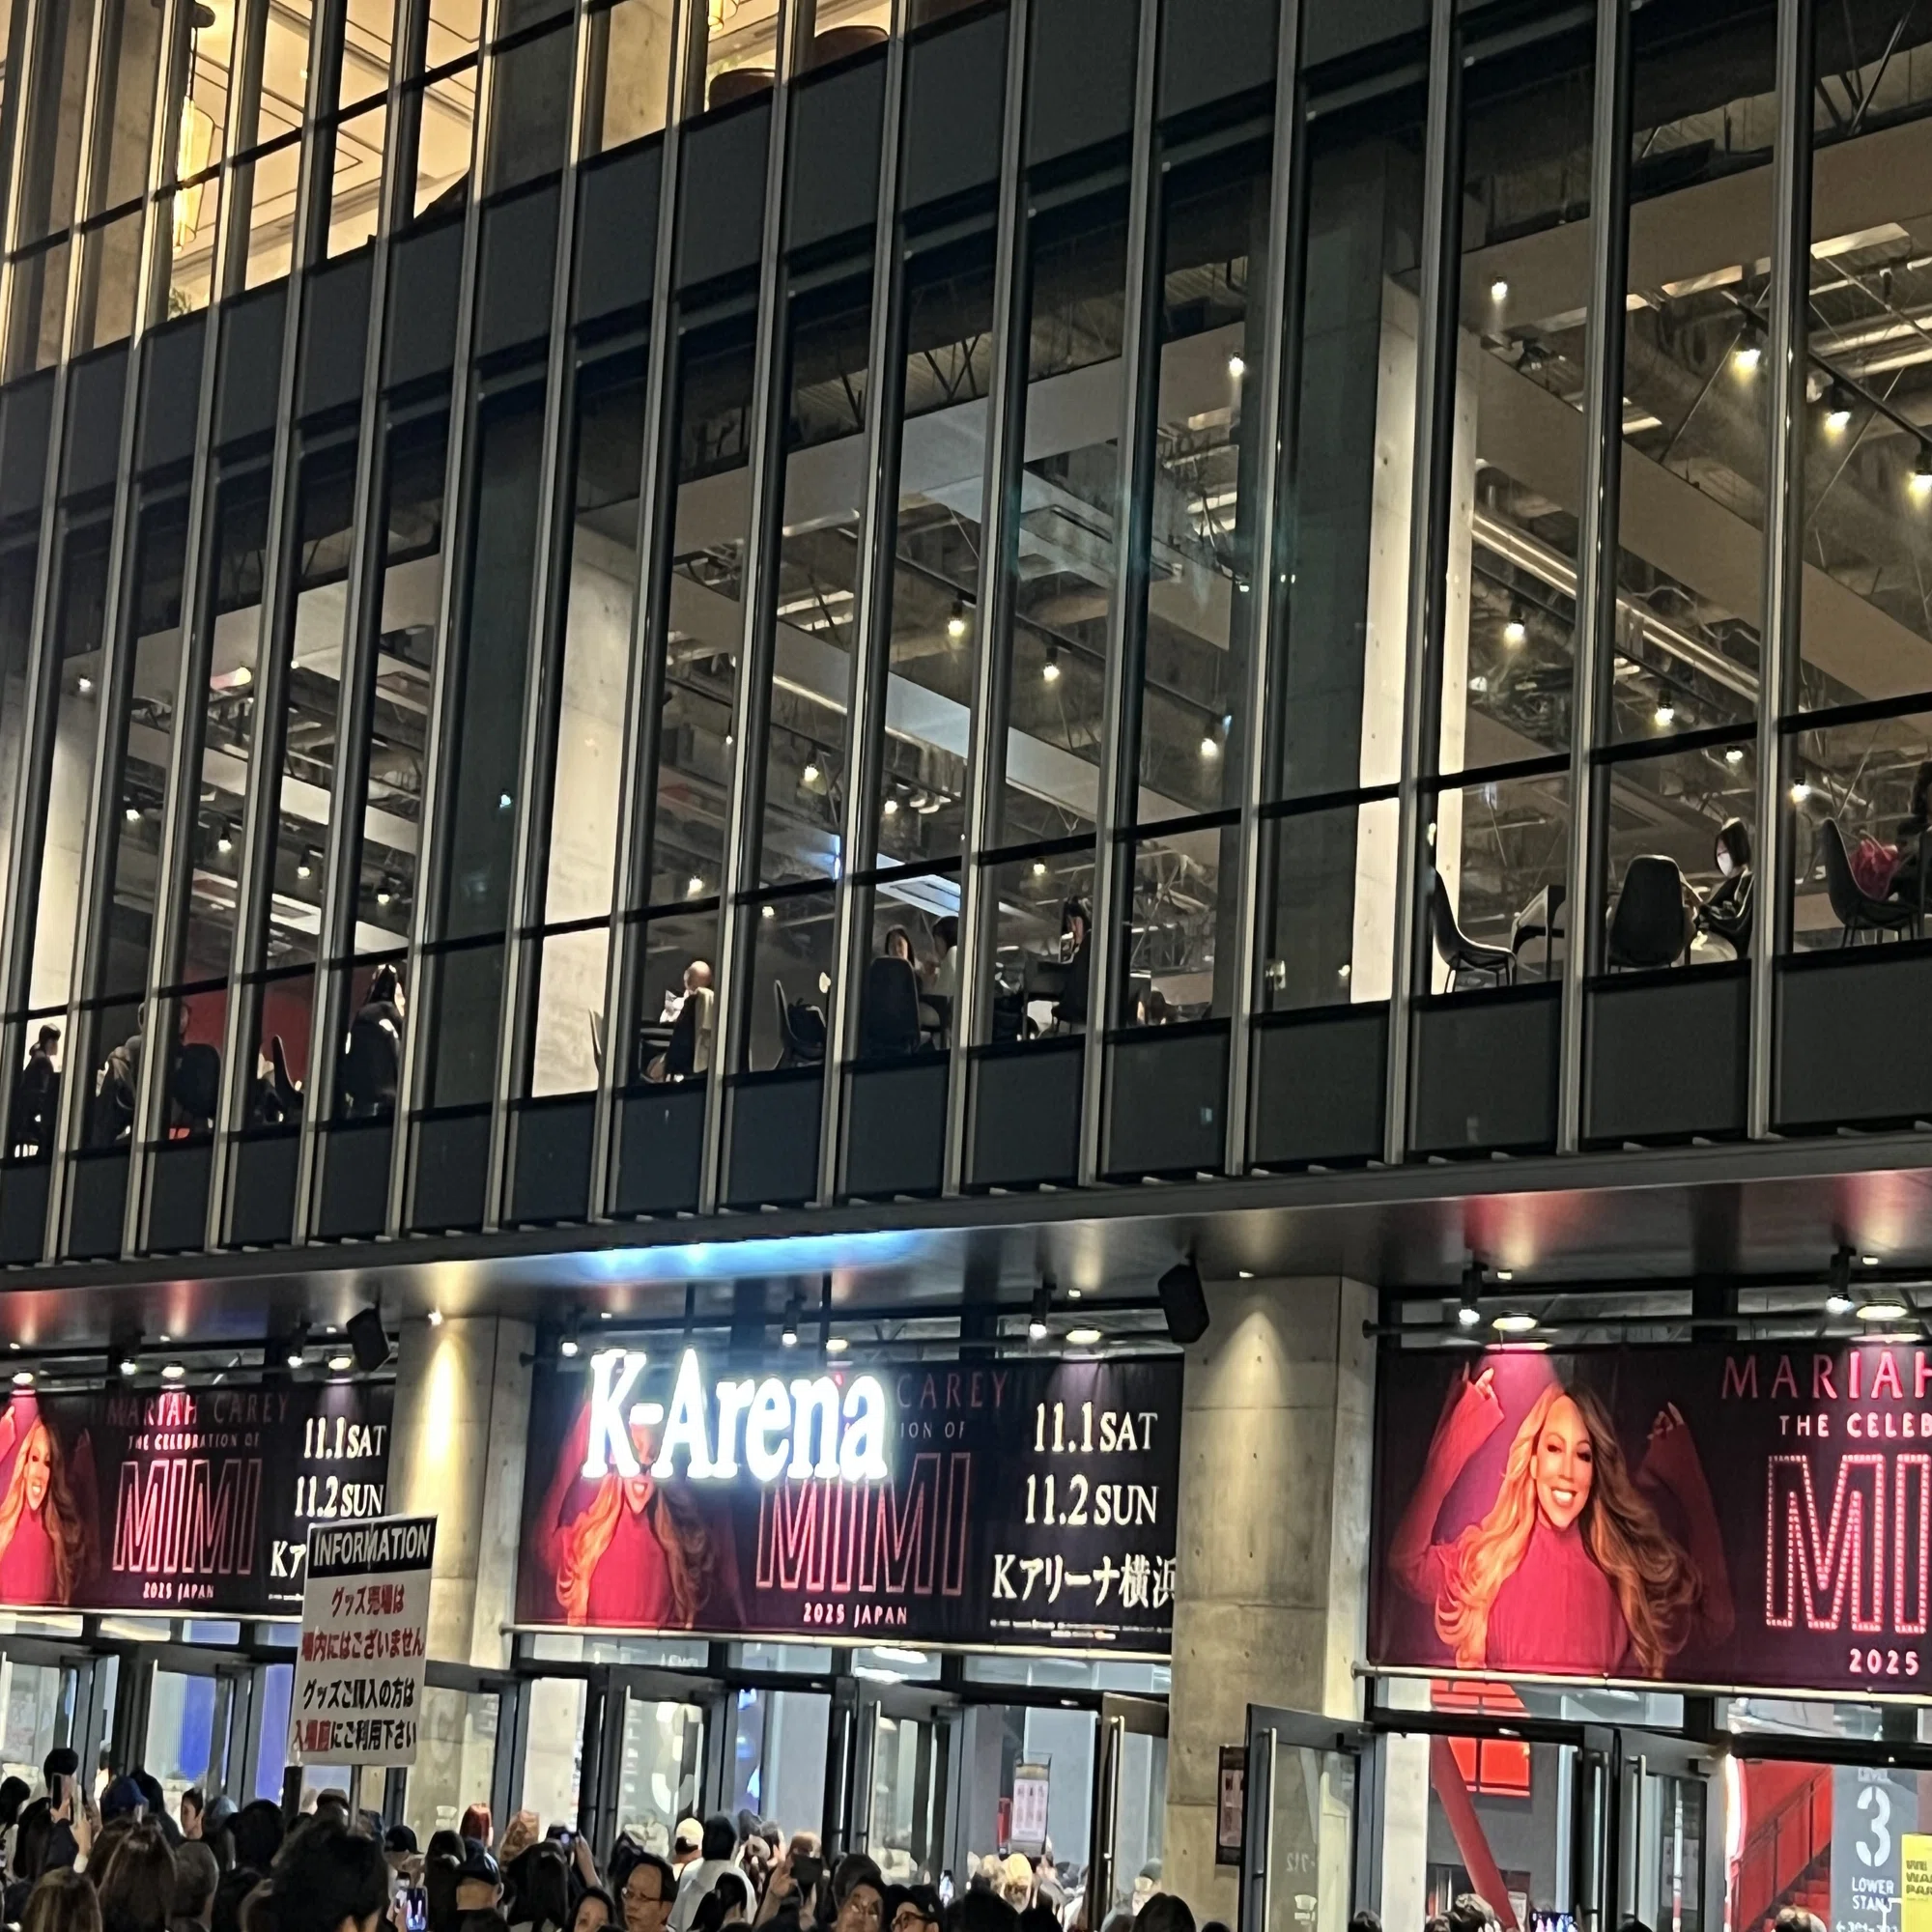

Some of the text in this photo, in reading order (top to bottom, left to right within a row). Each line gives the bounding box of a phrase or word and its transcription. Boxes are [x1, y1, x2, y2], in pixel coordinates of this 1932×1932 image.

[896, 1371, 1008, 1408] CAREY
[106, 1390, 289, 1427] MARIAH CAREY
[582, 1348, 888, 1481] K-Arena
[1779, 1414, 1830, 1437] THE
[128, 1435, 149, 1451] THE
[154, 1433, 238, 1451] CELEBRATION
[112, 1459, 263, 1575] MIMI
[755, 1452, 971, 1597] MIMI
[313, 1523, 431, 1567] INFORMATION
[143, 1581, 214, 1601] 2025 JAPAN
[992, 1553, 1177, 1608] Kアリーナ横浜
[803, 1602, 908, 1628] 2025 JAPAN
[1849, 1648, 1919, 1676] 2025
[1856, 1786, 1890, 1866] 3
[1852, 1877, 1894, 1895] LOWER
